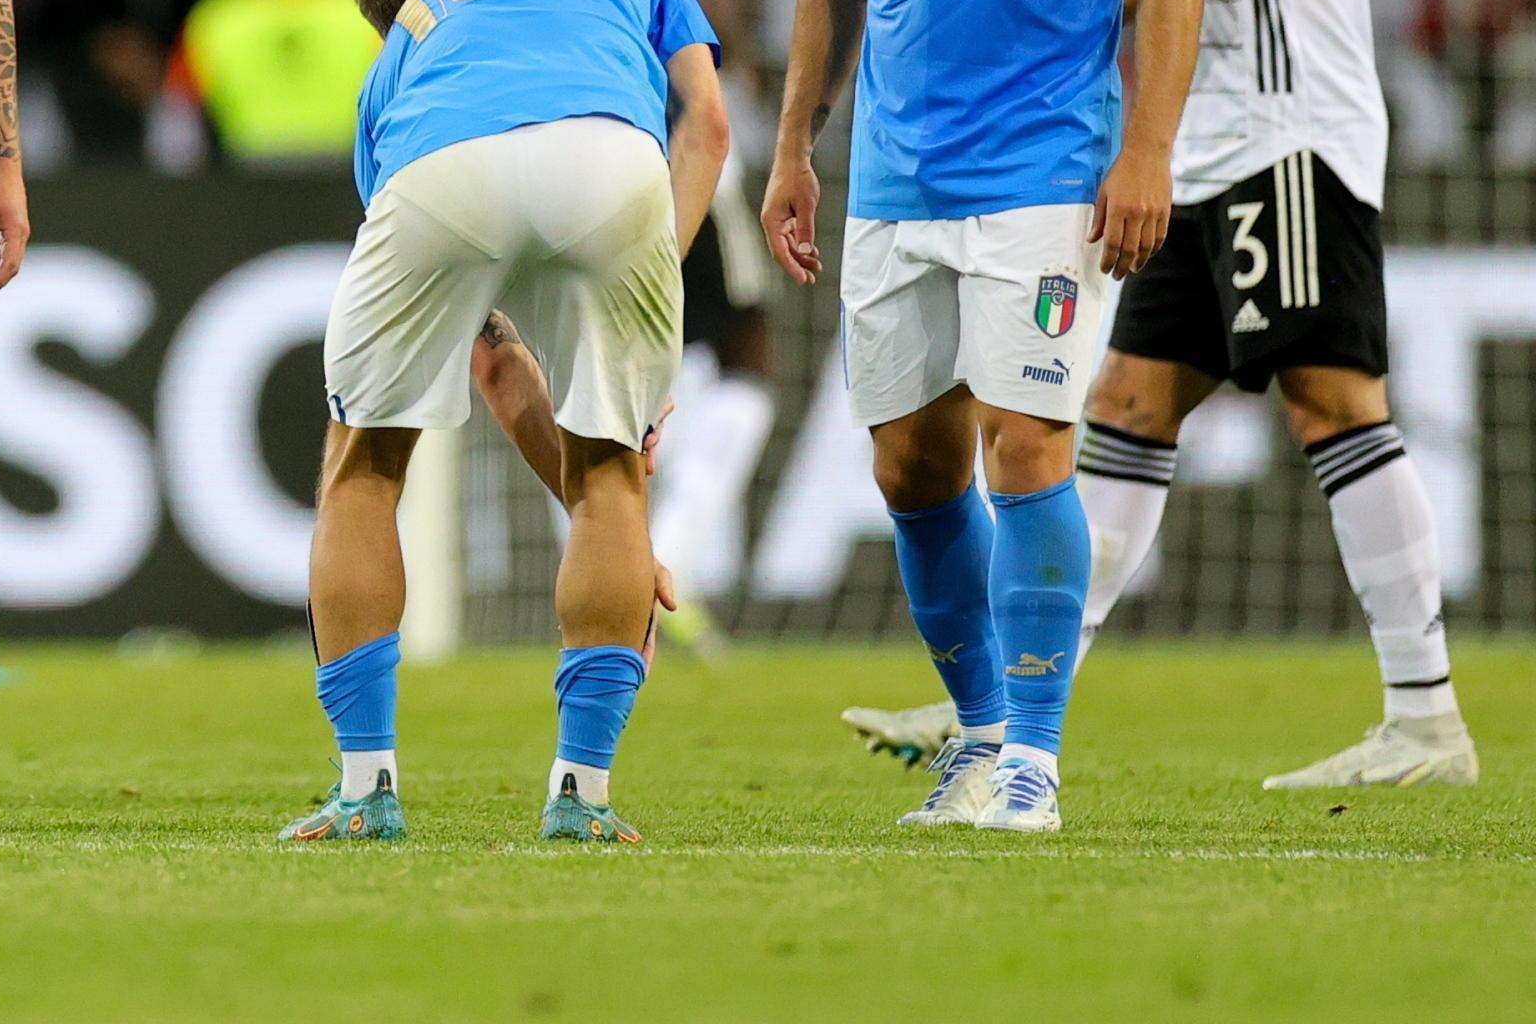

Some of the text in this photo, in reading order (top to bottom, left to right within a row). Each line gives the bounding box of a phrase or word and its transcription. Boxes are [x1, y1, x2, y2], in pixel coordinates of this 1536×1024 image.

[1227, 201, 1269, 290] 3
[1041, 279, 1076, 293] ITALIA
[1022, 365, 1064, 385] PUMA
